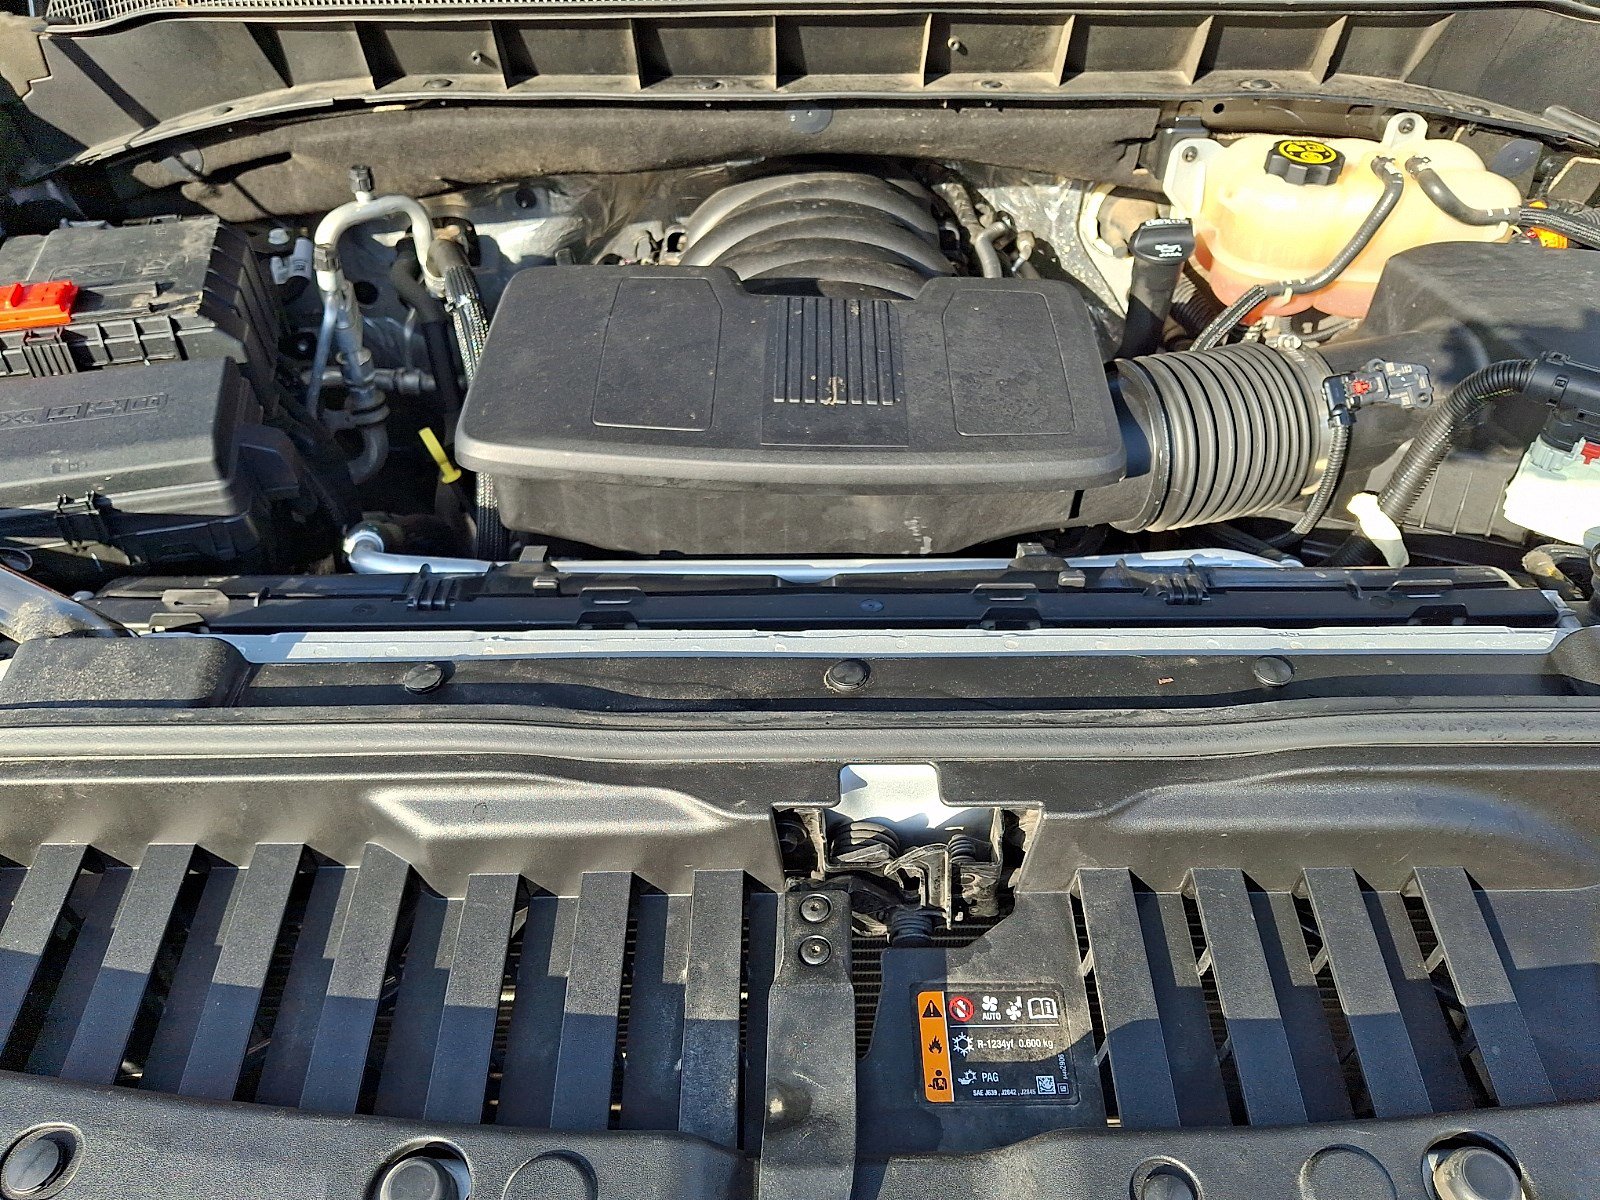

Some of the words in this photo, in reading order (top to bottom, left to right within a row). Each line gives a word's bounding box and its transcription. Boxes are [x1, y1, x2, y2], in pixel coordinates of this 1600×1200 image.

[982, 1012, 1001, 1020] AUTO
[977, 1038, 1014, 1050] R-1234yf
[1018, 1039, 1041, 1049] 0.600
[1042, 1039, 1054, 1049] kg
[981, 1072, 999, 1082] PAG
